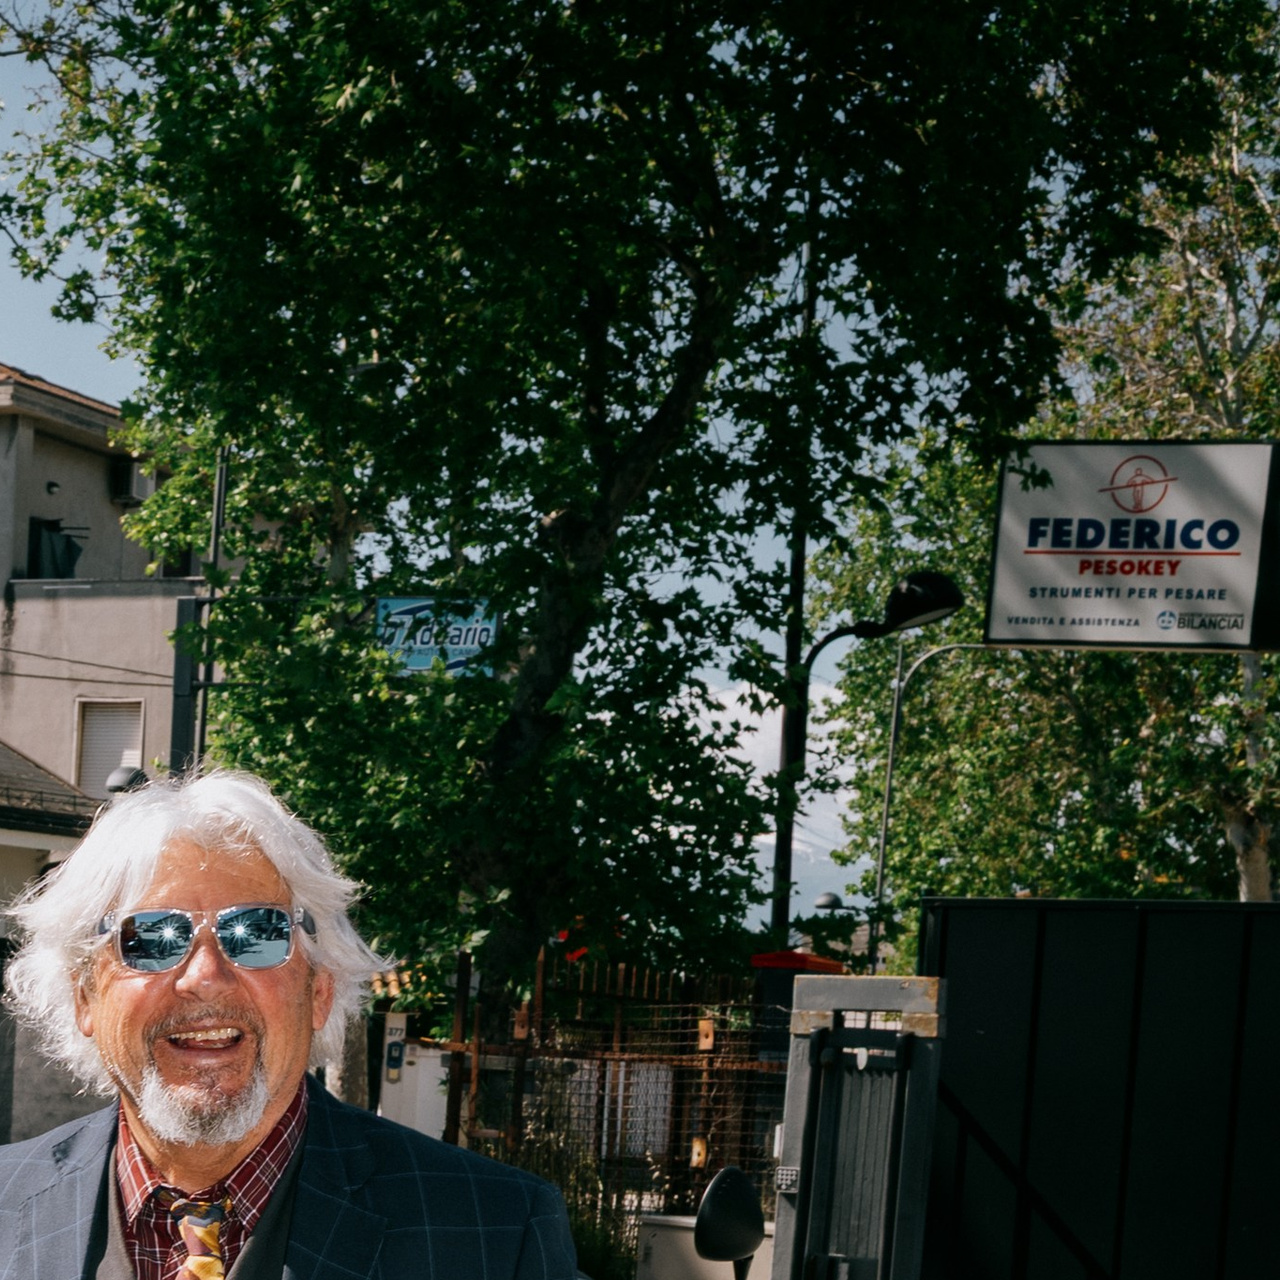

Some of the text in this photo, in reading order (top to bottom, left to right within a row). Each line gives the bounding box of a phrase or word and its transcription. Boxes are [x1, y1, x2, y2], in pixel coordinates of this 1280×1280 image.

[1027, 517, 1240, 550] FEDERICO
[1078, 559, 1182, 576] PESOKEY
[1029, 586, 1227, 601] STRUMENTI PER PESARE
[1007, 616, 1140, 627] VENDITA E ASSISTENZA
[1176, 616, 1245, 631] BILANCIAI
